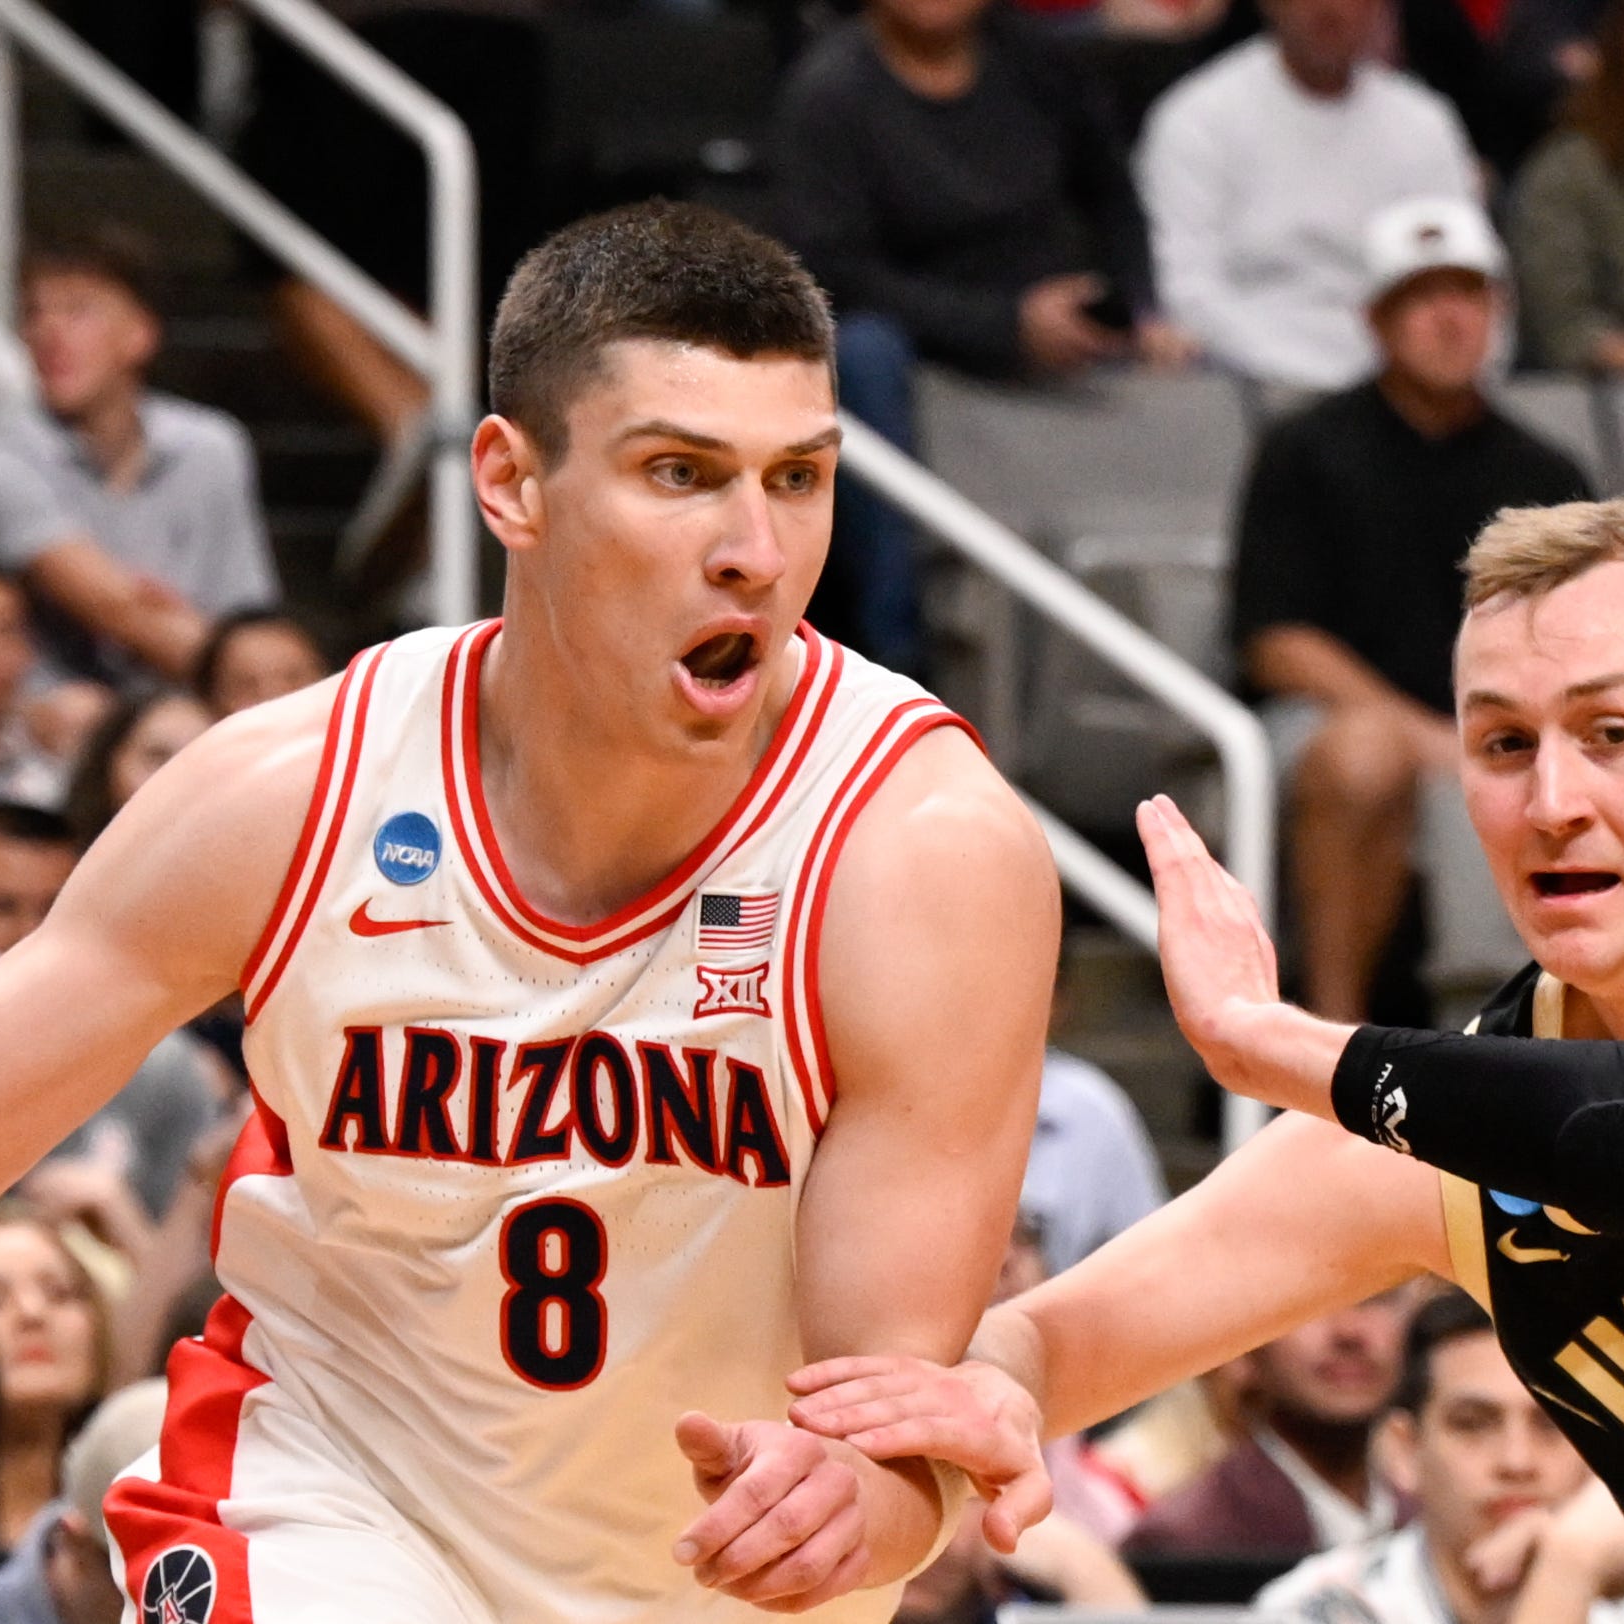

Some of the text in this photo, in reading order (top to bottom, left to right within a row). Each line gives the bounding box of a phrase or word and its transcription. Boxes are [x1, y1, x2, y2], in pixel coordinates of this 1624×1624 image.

[382, 842, 435, 868] NCAA
[698, 967, 767, 1013] XII
[318, 1026, 790, 1188] ARIZONA
[499, 1196, 608, 1392] 8
